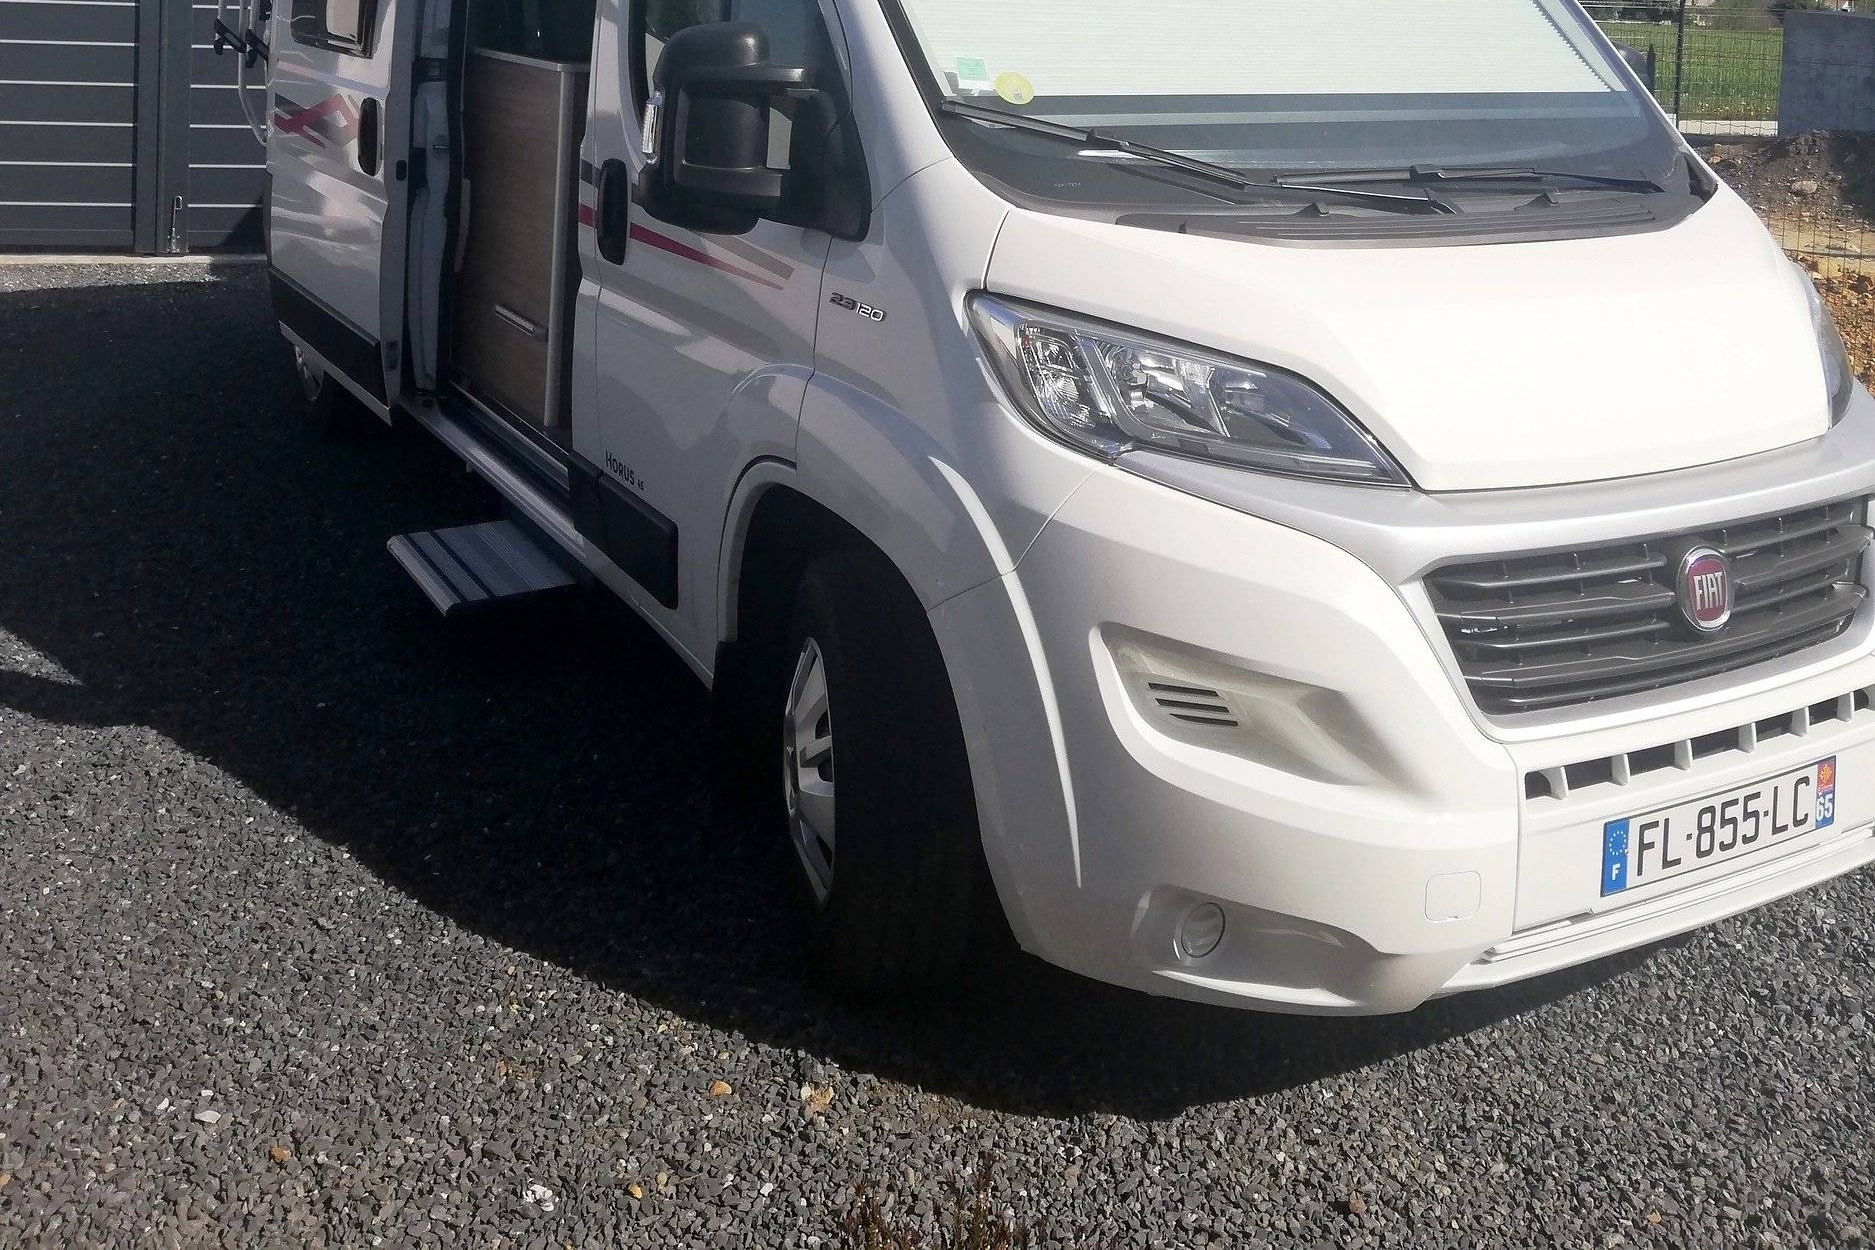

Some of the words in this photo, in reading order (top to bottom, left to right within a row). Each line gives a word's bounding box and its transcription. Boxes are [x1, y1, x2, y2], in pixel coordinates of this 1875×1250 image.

[605, 449, 635, 486] HORUS
[1693, 571, 1725, 610] FIAT
[1612, 863, 1620, 881] F
[1816, 793, 1833, 822] 65
